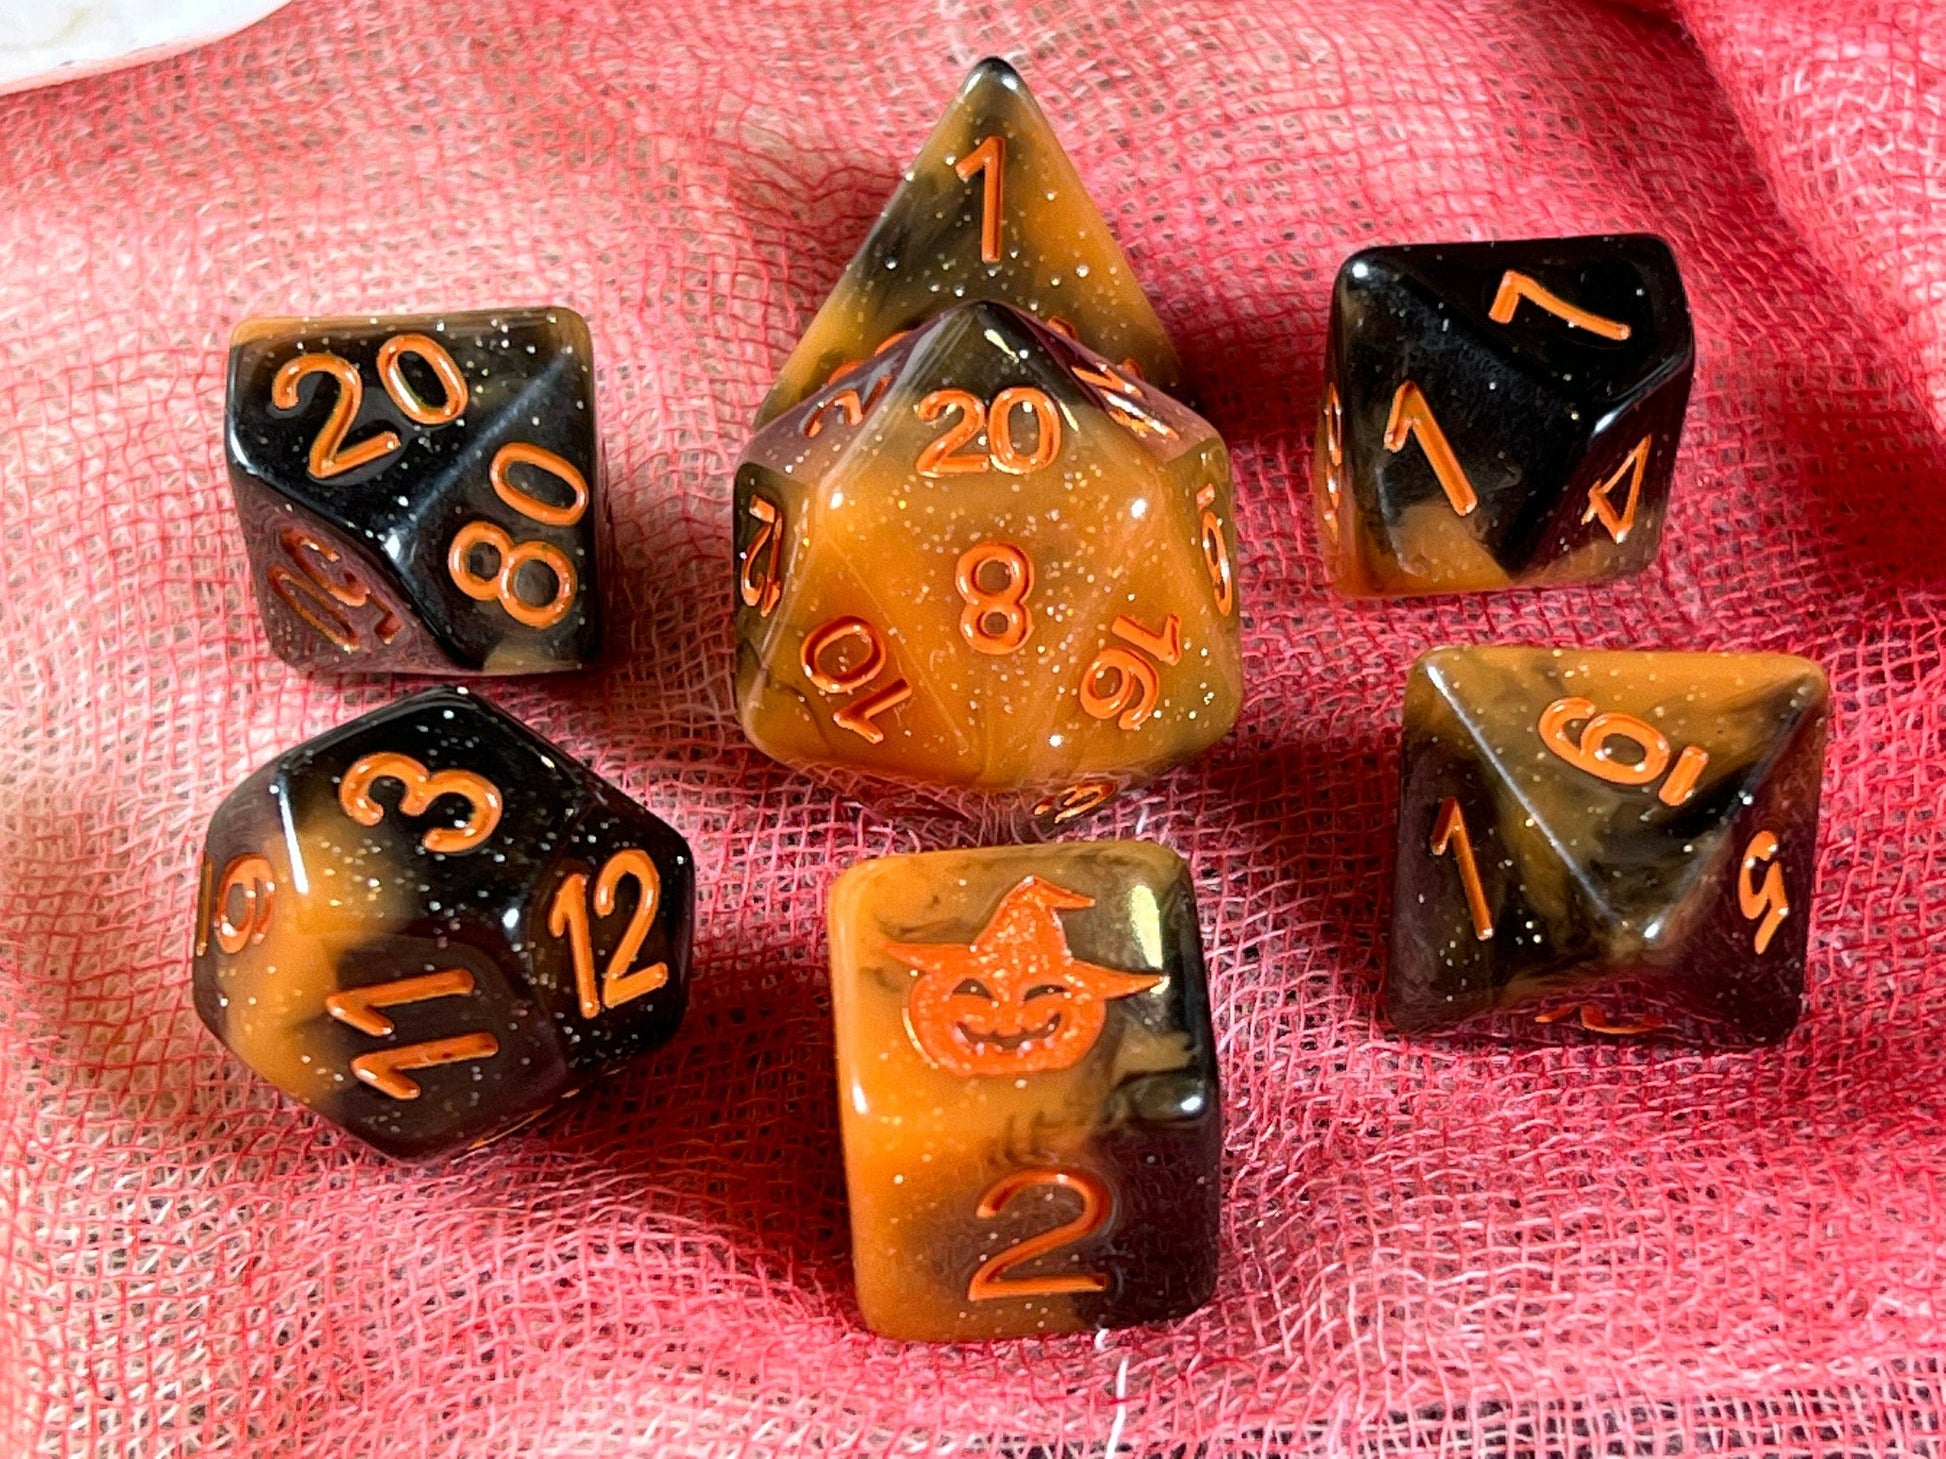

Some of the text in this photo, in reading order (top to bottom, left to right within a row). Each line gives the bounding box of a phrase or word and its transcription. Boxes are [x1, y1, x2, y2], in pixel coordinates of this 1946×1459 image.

[955, 135, 1006, 262] 1
[1489, 270, 1632, 341] 7
[271, 333, 468, 479] 20
[914, 386, 1061, 478] 20
[1384, 380, 1478, 516] 1
[448, 442, 589, 631] 80
[1581, 435, 1652, 544] 4
[955, 542, 1035, 655] 8
[801, 615, 912, 744] 10
[1080, 613, 1182, 730] 16
[338, 752, 503, 853] 3
[1431, 796, 1494, 940] 1
[549, 849, 669, 1018] 12
[326, 968, 498, 1099] 11
[968, 1168, 1108, 1300] 2
